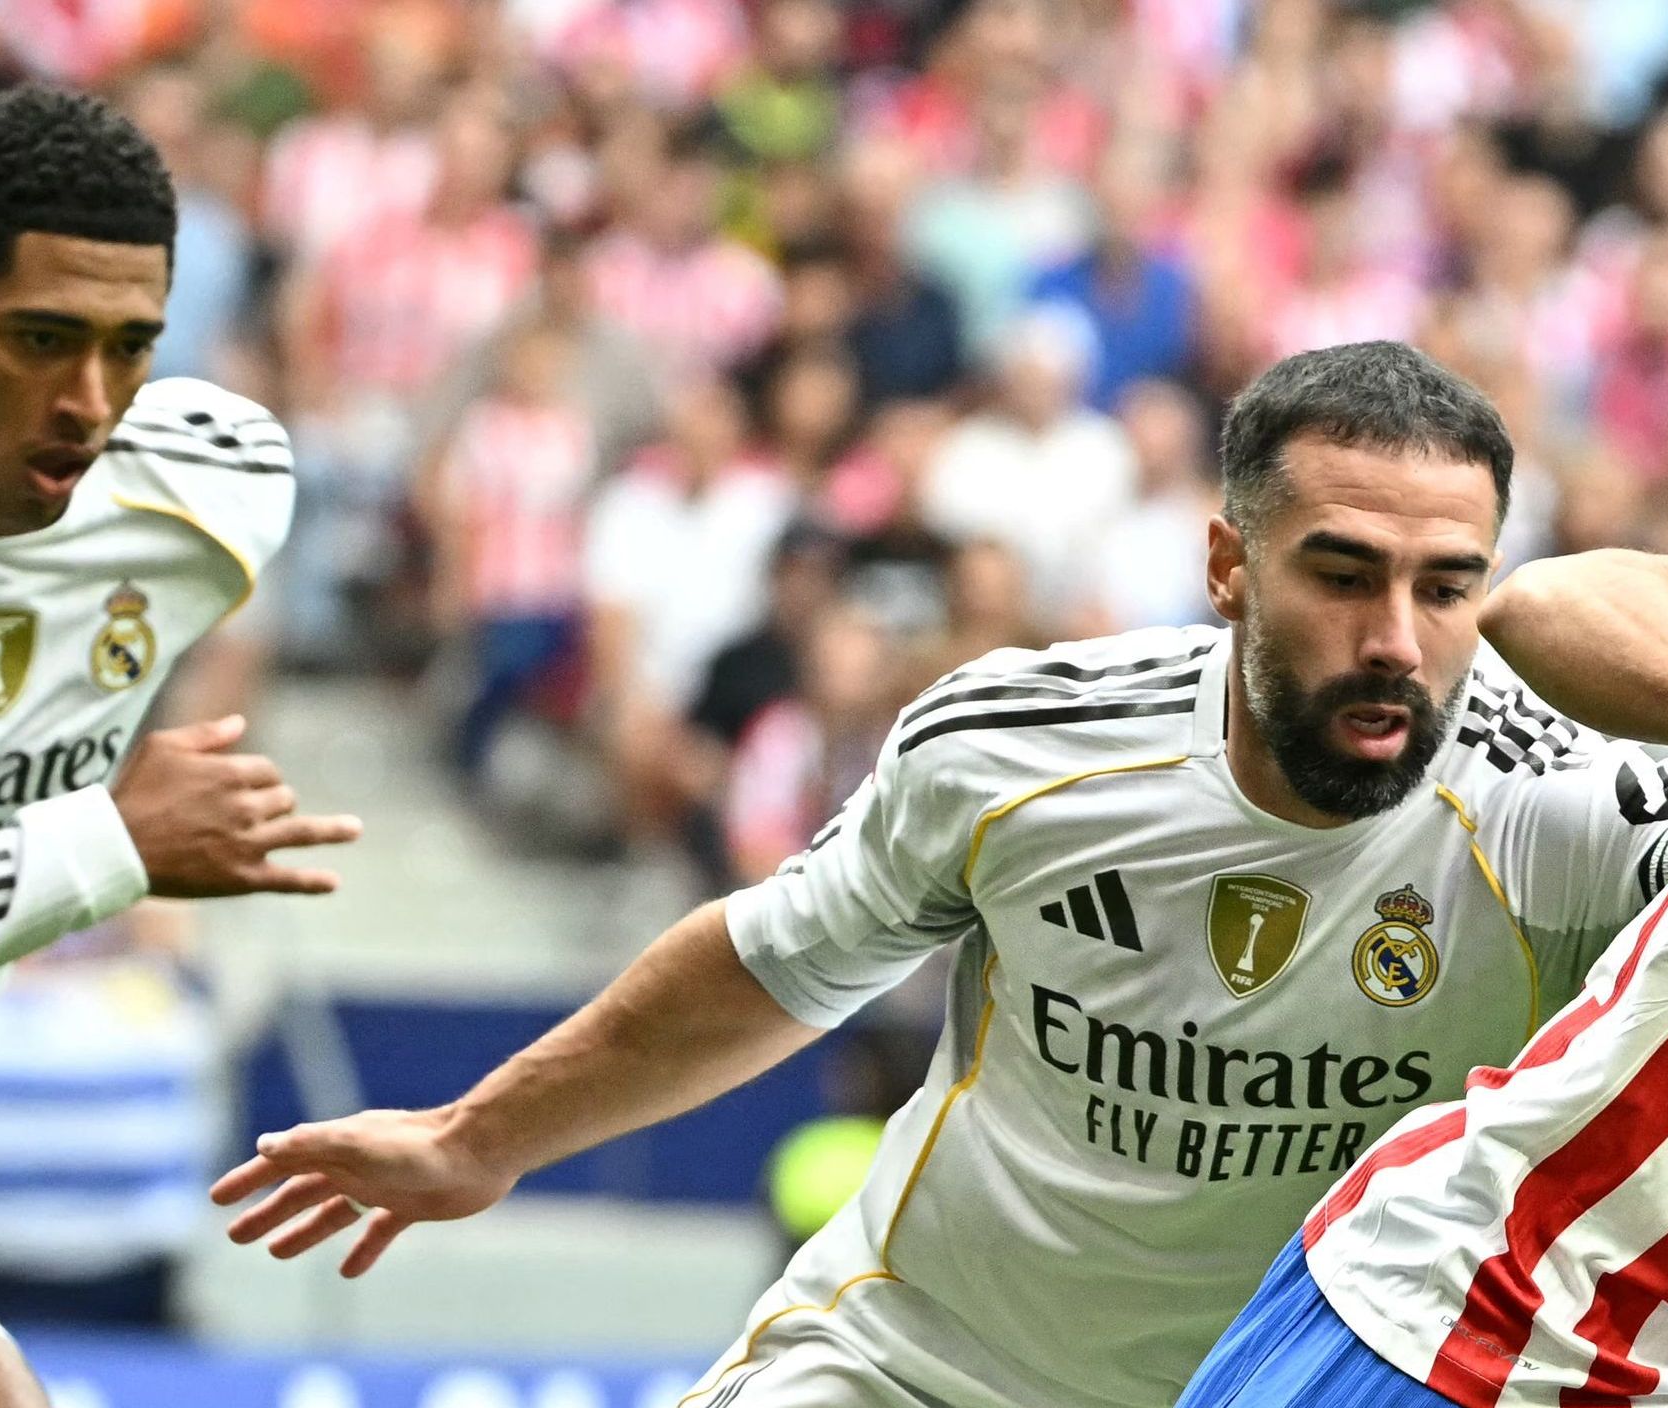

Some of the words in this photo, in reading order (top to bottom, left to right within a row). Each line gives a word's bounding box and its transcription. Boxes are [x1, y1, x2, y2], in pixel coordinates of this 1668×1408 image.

[1230, 973, 1253, 987] FIFA
[1030, 983, 1433, 1111] Emirates
[1084, 1098, 1159, 1164] FLY
[1176, 1117, 1367, 1183] BETTER
